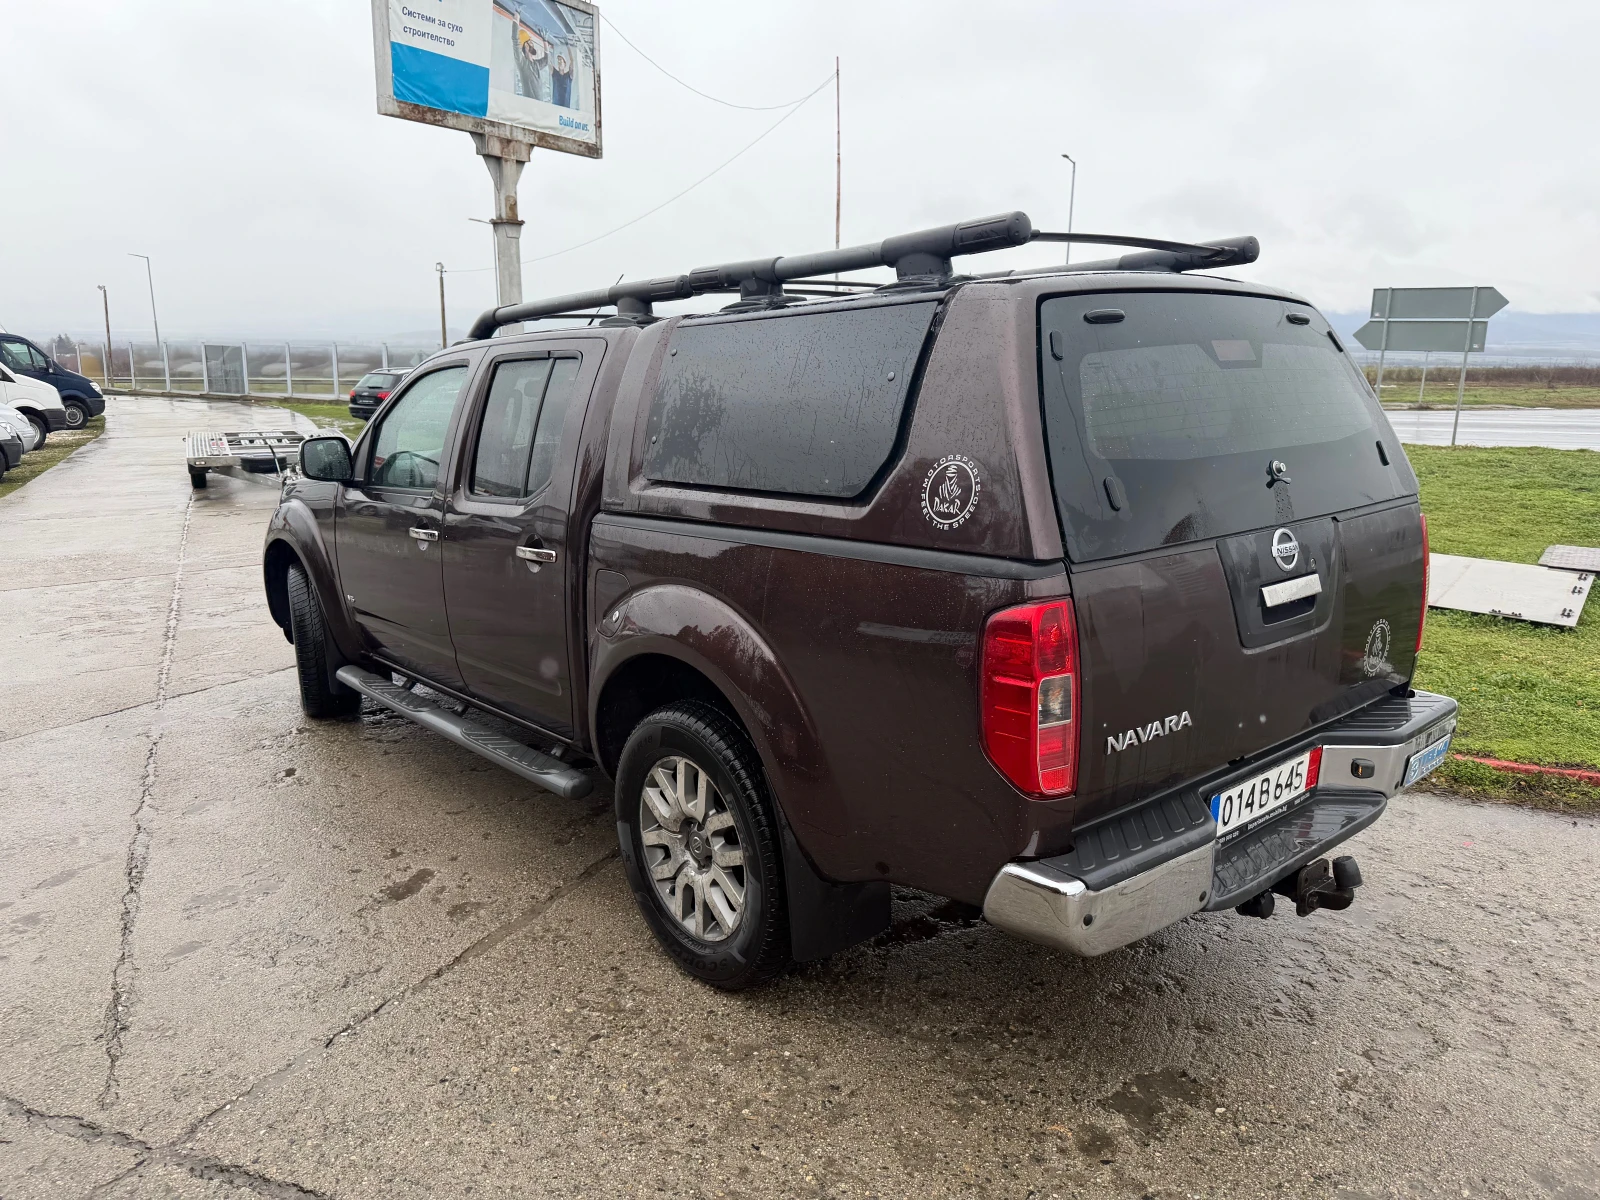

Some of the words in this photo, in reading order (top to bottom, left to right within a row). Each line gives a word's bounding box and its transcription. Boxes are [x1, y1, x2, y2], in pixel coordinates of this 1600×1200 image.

[402, 6, 436, 25] Системи
[437, 19, 446, 28] за
[447, 22, 463, 33] сухо
[403, 25, 455, 47] строителство
[559, 115, 575, 128] Build
[921, 493, 930, 521] FEEL
[932, 520, 950, 531] THE
[952, 496, 979, 529] SPEED
[1276, 544, 1299, 556] NISSAN
[1106, 710, 1193, 756] NAVARA
